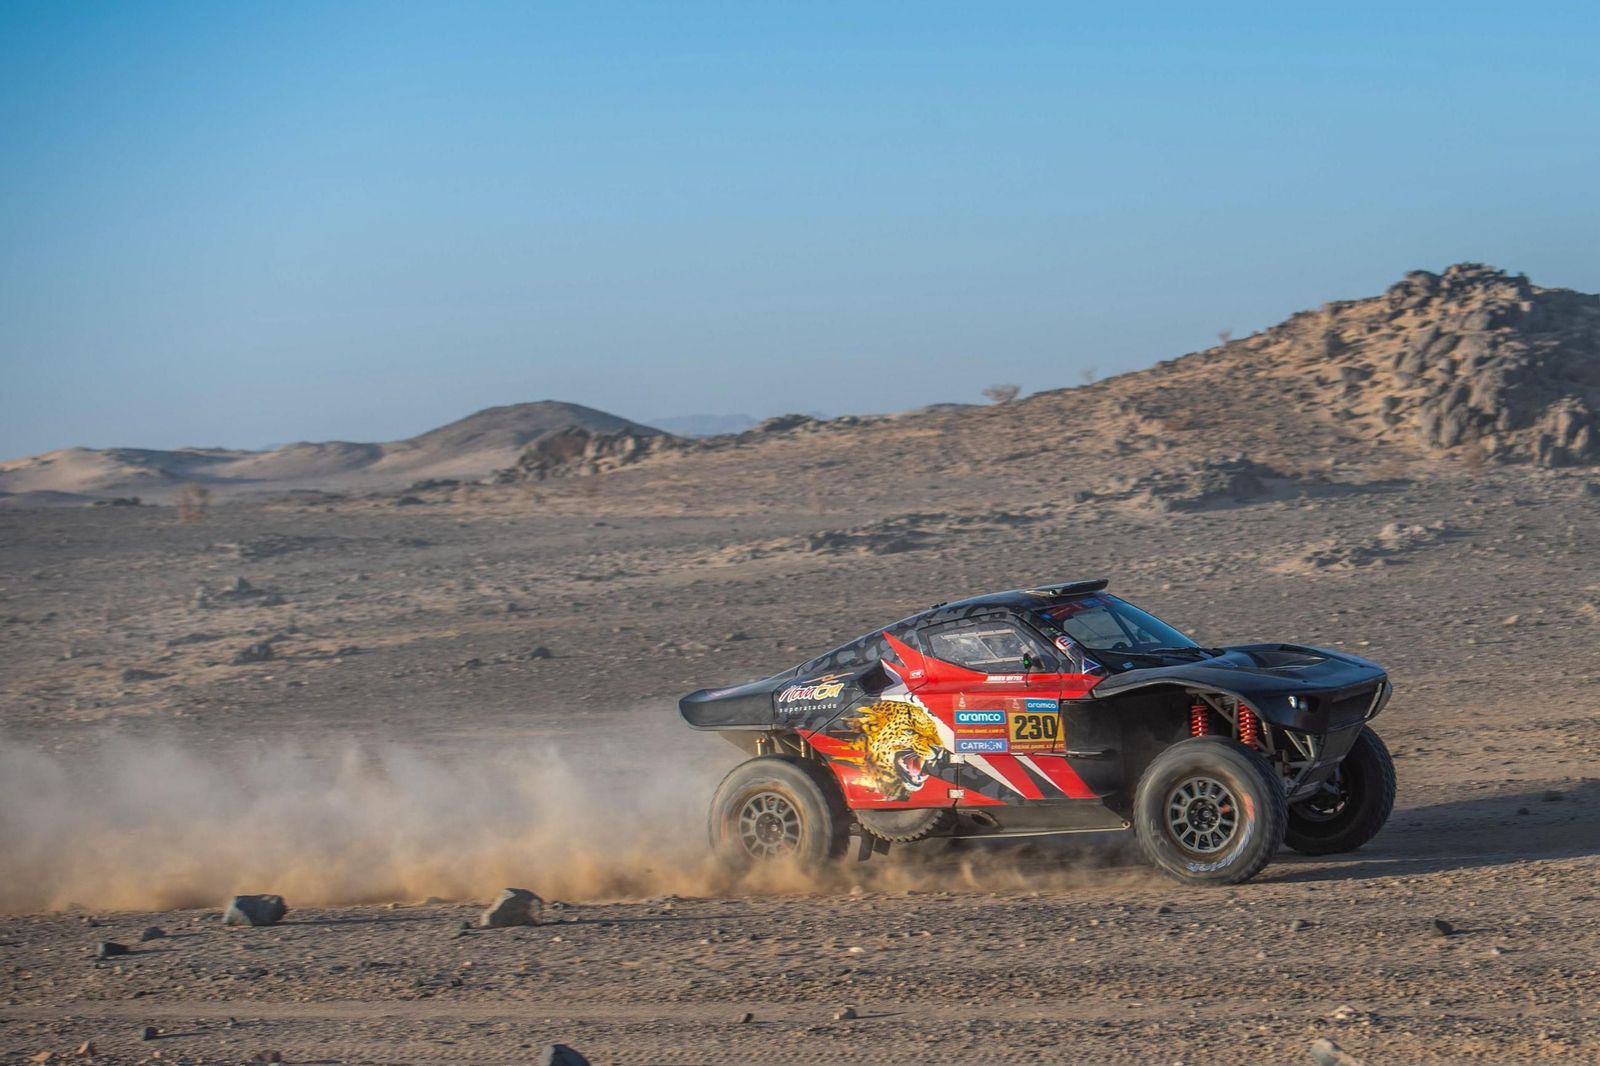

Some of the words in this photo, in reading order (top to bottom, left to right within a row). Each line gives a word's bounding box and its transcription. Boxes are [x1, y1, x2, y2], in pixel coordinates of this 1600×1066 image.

[779, 703, 837, 713] superatacado
[959, 713, 1001, 721] aramco
[1014, 715, 1056, 739] 230
[961, 741, 1002, 751] CATRION
